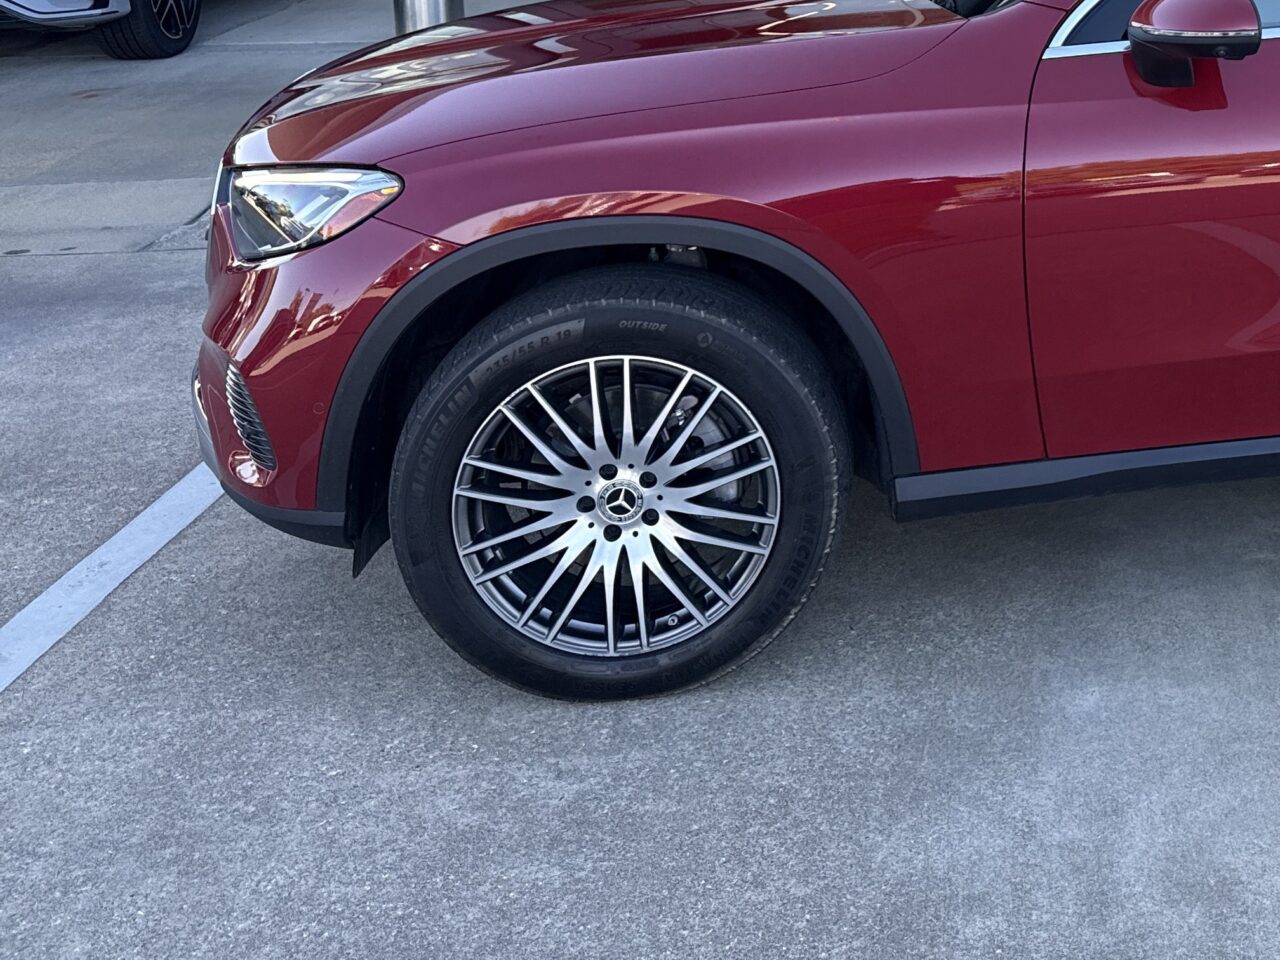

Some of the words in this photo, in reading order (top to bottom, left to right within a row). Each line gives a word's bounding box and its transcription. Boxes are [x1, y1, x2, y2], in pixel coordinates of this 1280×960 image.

[618, 320, 668, 332] OUTSIDE
[410, 382, 475, 496] MICHELIN
[485, 341, 538, 375] 235/55
[540, 336, 550, 346] R
[557, 329, 572, 341] 19
